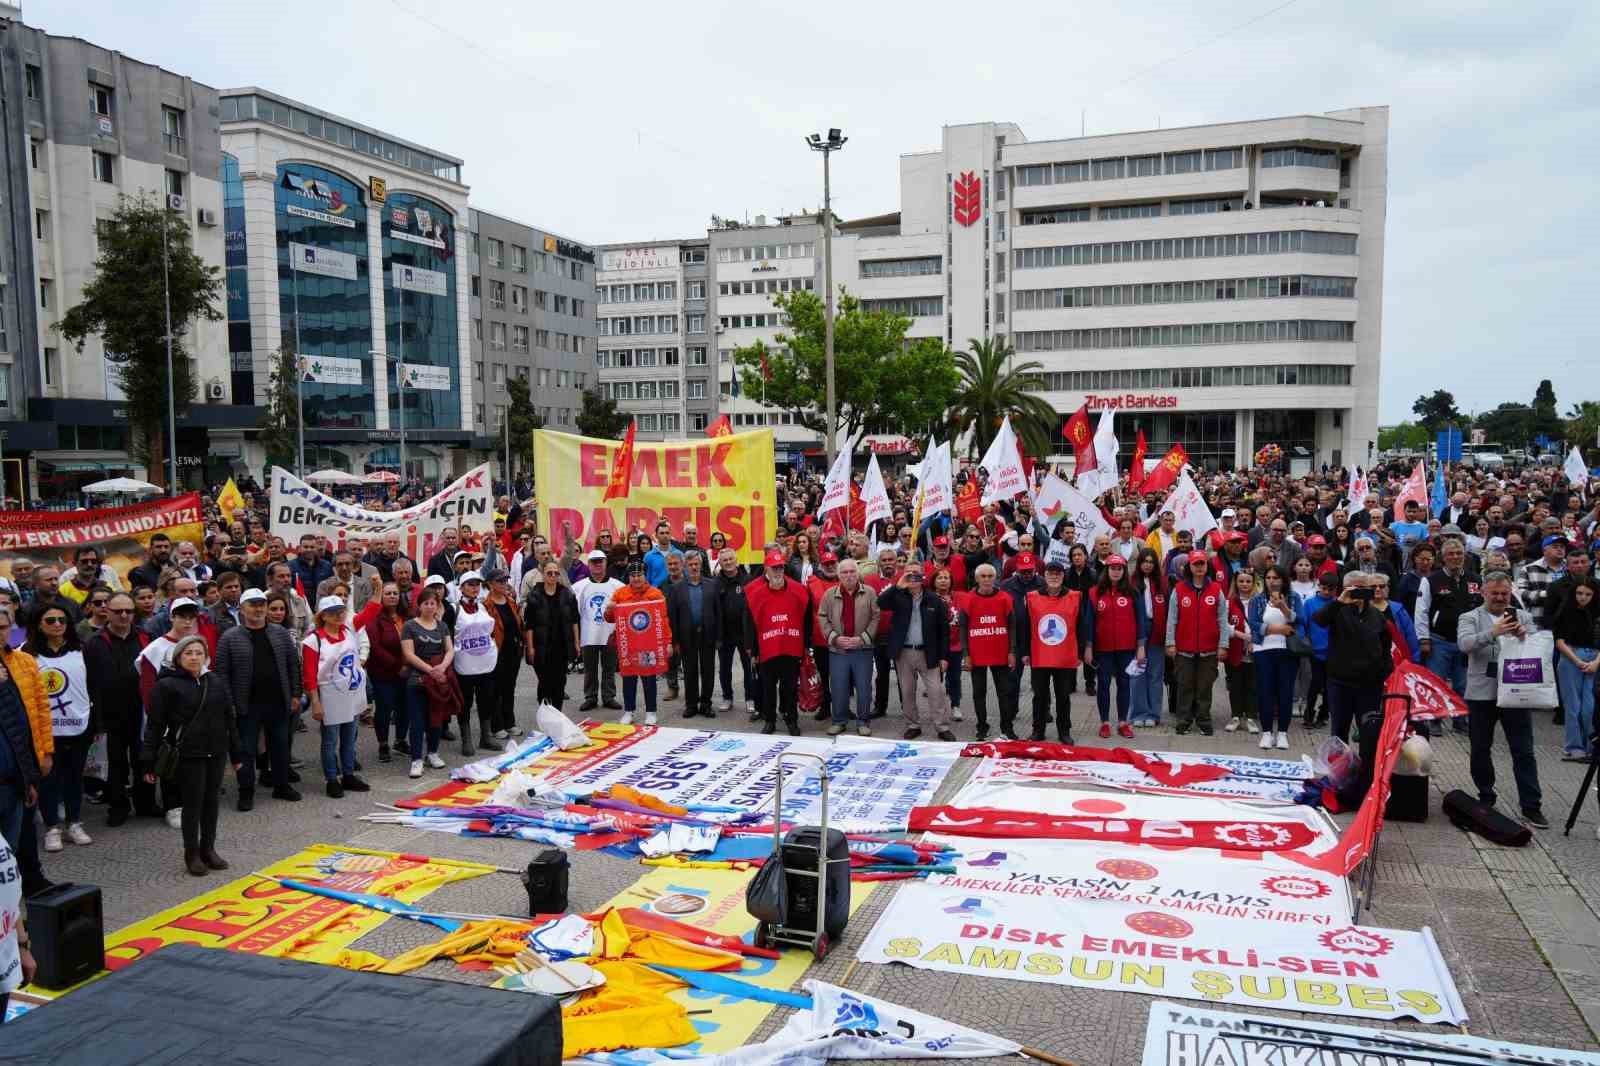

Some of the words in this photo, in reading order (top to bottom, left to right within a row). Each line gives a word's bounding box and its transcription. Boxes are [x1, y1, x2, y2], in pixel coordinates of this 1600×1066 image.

[625, 247, 656, 257] OTEL
[1126, 394, 1177, 409] Bankası
[580, 442, 736, 488] EMEK
[79, 507, 199, 541] YOLUNDAYIZ!
[771, 614, 788, 623] DİSK
[980, 615, 997, 624] DİSK
[573, 755, 639, 784] SAMSUN
[637, 761, 708, 791] SES
[940, 876, 1046, 897] EMEKLİLER
[1160, 897, 1249, 919] SAMSUN
[1145, 884, 1162, 896] 1
[1171, 888, 1273, 908] MAYIS
[960, 923, 1067, 948] DİSK
[1082, 934, 1380, 978] EMEKLİ-SEN
[1335, 935, 1377, 948] DİSK
[883, 937, 1165, 989] SAMSUN
[1168, 1011, 1251, 1032] TABAN
